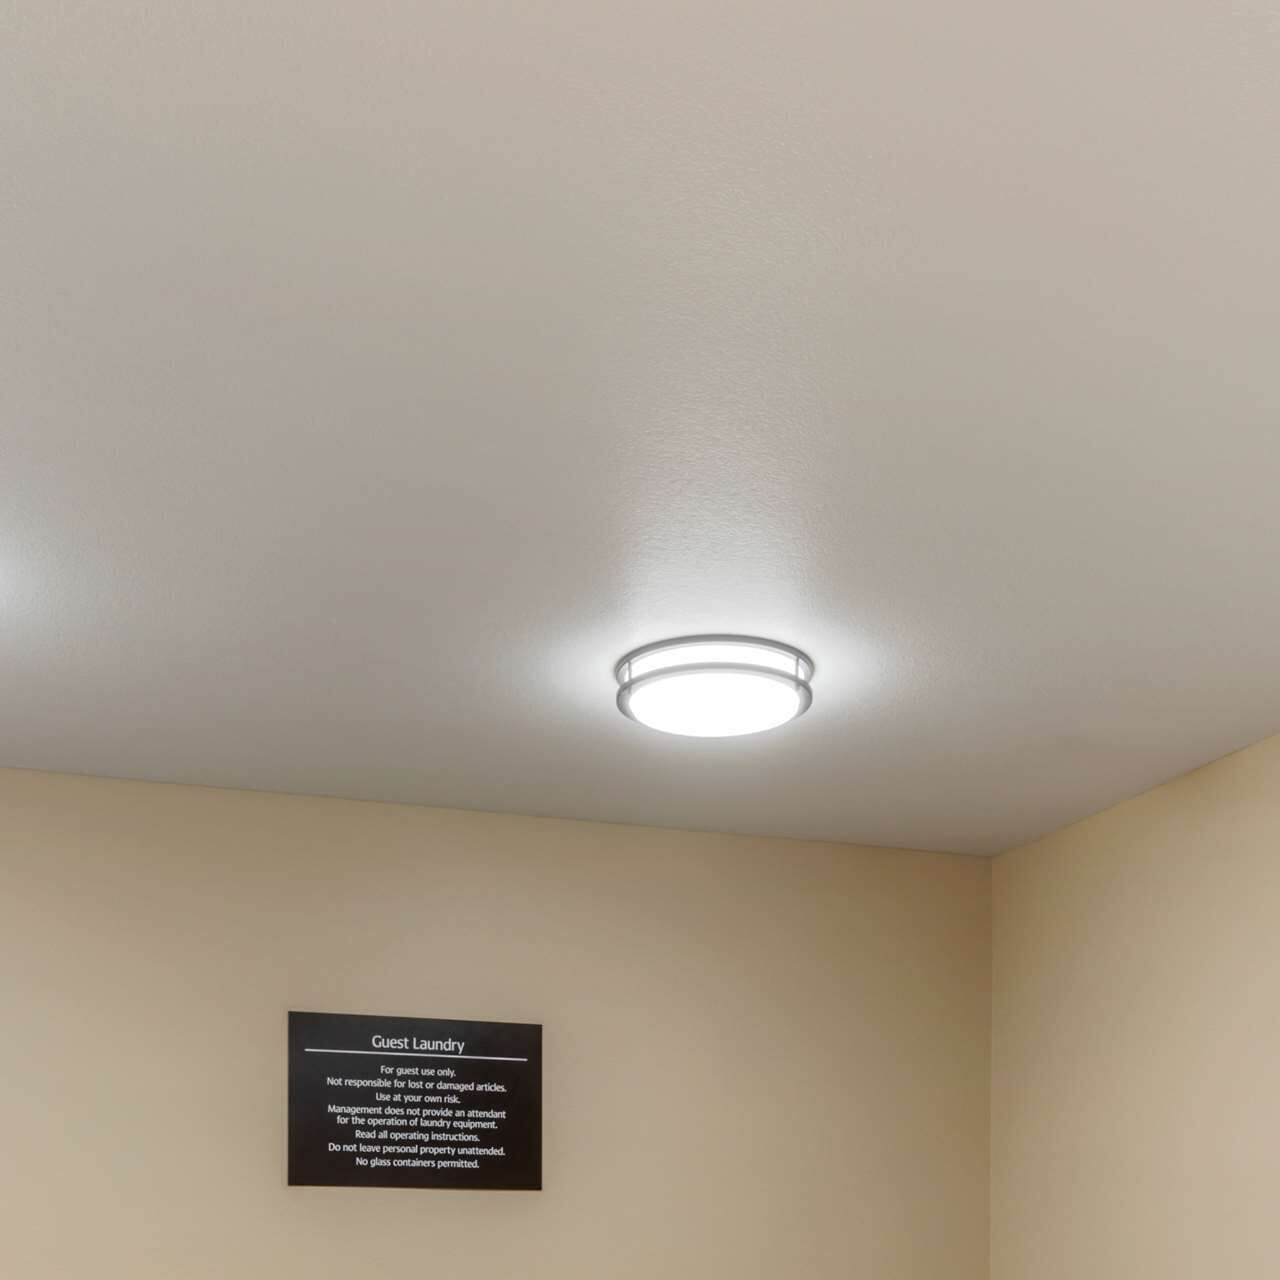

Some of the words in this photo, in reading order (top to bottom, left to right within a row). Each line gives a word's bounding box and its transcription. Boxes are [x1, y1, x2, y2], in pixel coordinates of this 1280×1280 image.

[371, 1035, 409, 1049] Guest
[413, 1037, 465, 1055] Laundry
[380, 1065, 394, 1074] For
[396, 1067, 419, 1076] guest
[421, 1068, 435, 1076] use
[437, 1067, 456, 1078] only.
[327, 1077, 342, 1086] Not
[344, 1078, 392, 1088] responsible
[394, 1079, 406, 1088] for
[408, 1080, 423, 1089] lost
[436, 1081, 475, 1092] damaged
[476, 1082, 507, 1092] articles.
[376, 1092, 391, 1101] Use
[393, 1093, 401, 1101] at
[403, 1094, 422, 1103] your
[423, 1095, 442, 1103] own
[444, 1094, 461, 1104] risk.
[328, 1104, 382, 1115] Management
[384, 1106, 404, 1115] does
[406, 1107, 420, 1116] not
[422, 1108, 453, 1117] provide
[467, 1109, 506, 1119] attendant
[336, 1115, 348, 1124] for
[351, 1116, 365, 1125] the
[367, 1117, 407, 1126] operation
[409, 1117, 418, 1126] of
[420, 1118, 451, 1129] laundry
[453, 1119, 498, 1130] equipment.
[355, 1130, 376, 1139] Read
[378, 1130, 388, 1139] all
[390, 1131, 429, 1142] operating
[431, 1131, 480, 1142] instructions.
[328, 1142, 341, 1152] Do
[342, 1144, 357, 1152] not
[359, 1144, 380, 1153] leave
[382, 1145, 418, 1154] personal
[420, 1146, 456, 1156] property
[457, 1146, 506, 1156] unattended.
[356, 1157, 368, 1166] No
[370, 1157, 391, 1168] glass
[393, 1157, 436, 1167] containers
[437, 1159, 480, 1169] permitted.
